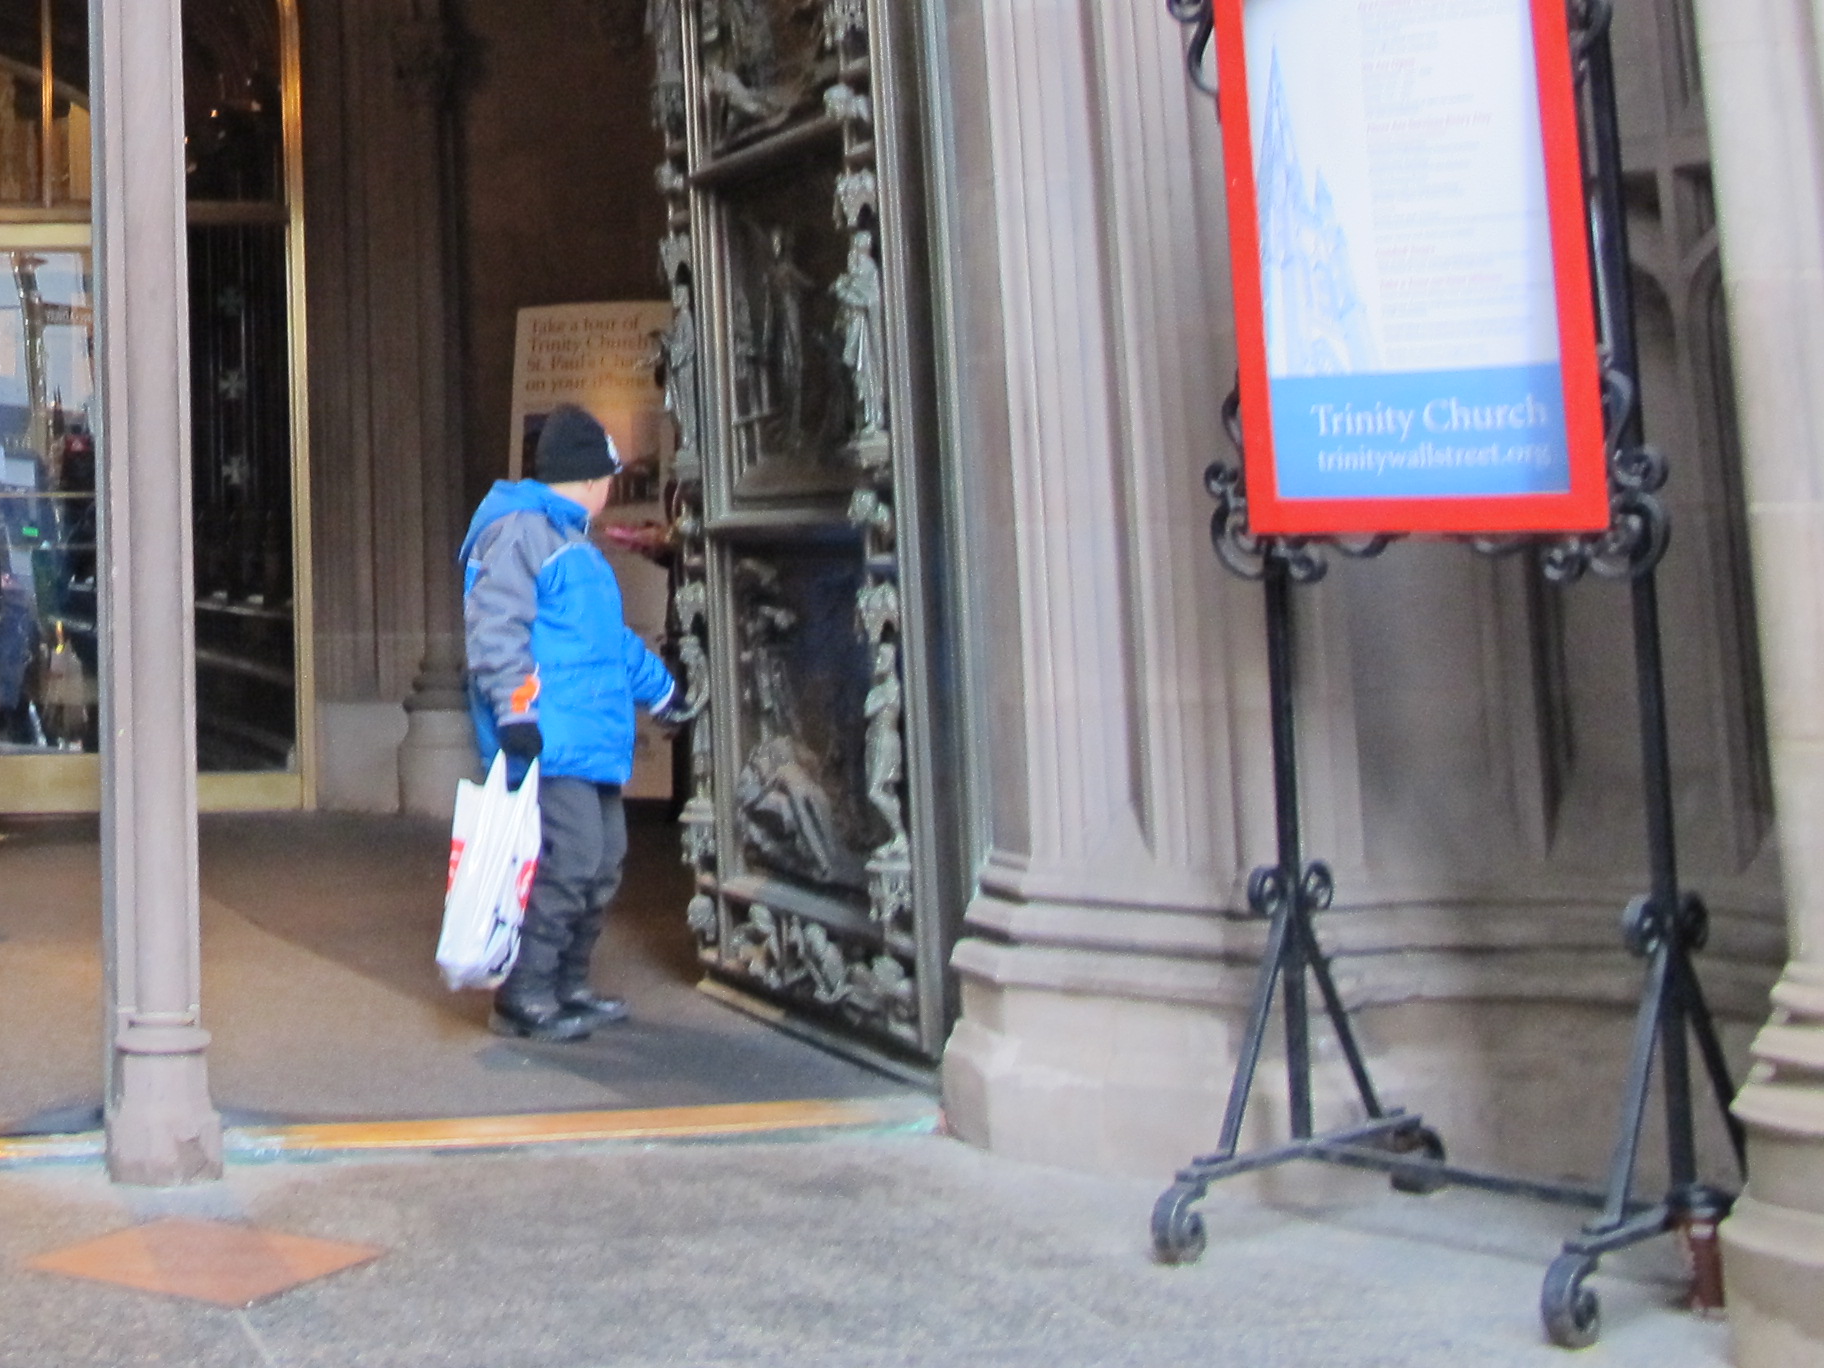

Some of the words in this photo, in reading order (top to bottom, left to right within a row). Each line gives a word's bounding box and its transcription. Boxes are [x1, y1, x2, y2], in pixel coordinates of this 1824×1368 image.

[528, 334, 582, 355] Trinity
[585, 332, 648, 351] Church
[525, 379, 546, 391] on
[551, 377, 586, 393] your
[1311, 401, 1415, 444] Trinity
[1422, 393, 1548, 432] Church
[1317, 440, 1552, 475] trinitywallstreet.org
